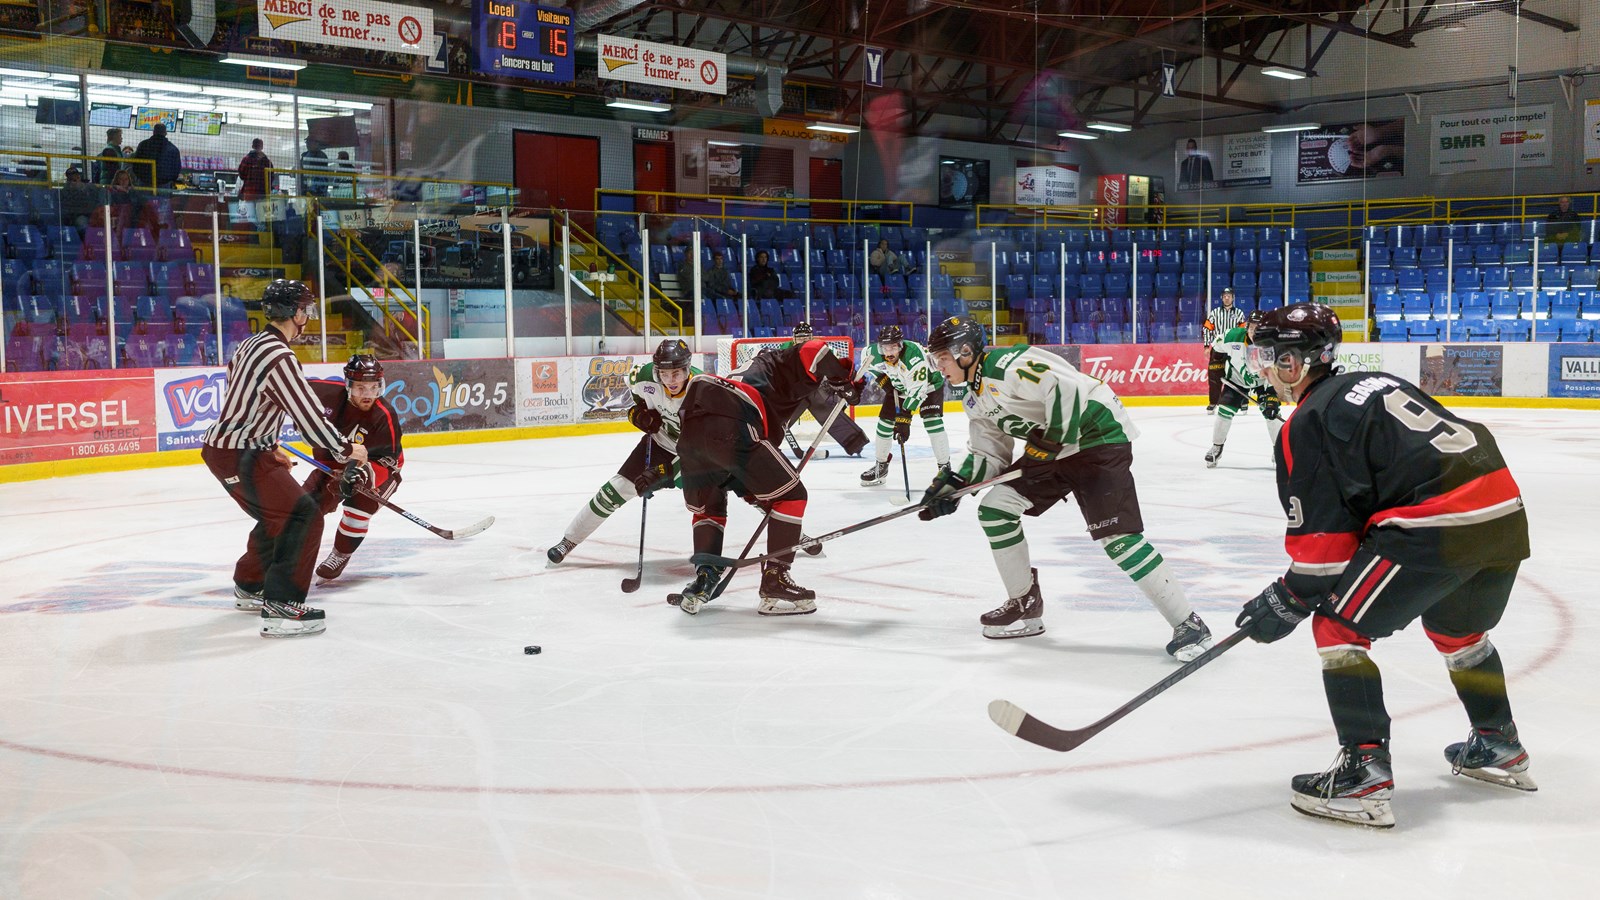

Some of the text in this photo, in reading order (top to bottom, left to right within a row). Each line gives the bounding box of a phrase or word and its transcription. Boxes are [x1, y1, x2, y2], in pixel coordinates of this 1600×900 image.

[319, 4, 336, 18] de
[342, 9, 360, 21] ne
[366, 13, 391, 26] pas
[489, 1, 514, 17] Local
[537, 10, 570, 25] Visiteurs
[549, 29, 567, 56] 16
[501, 54, 554, 73] lancers au but
[642, 50, 655, 62] de
[660, 55, 673, 65] ne
[677, 58, 695, 69] pas
[867, 53, 880, 83] Y
[1163, 67, 1174, 96] X
[1440, 120, 1459, 128] Pour
[1462, 118, 1479, 127] tout
[1493, 115, 1506, 125] qui
[1509, 111, 1546, 123] compte!
[638, 128, 669, 141] FEMMES
[1440, 133, 1486, 150] BMR
[1228, 151, 1248, 159] VOTRE
[1521, 151, 1545, 159] Avantis
[1325, 250, 1354, 259] Desjardins
[1327, 273, 1357, 282] Desjardins
[1329, 297, 1360, 305] Desjardins
[1339, 320, 1364, 329] sjardins
[1447, 348, 1501, 358] Pralinière
[589, 356, 634, 377] Cool
[913, 366, 927, 381] 18
[1016, 360, 1051, 384] 16
[1085, 354, 1208, 384] Tim Horton
[1566, 360, 1600, 374] VALL
[441, 382, 508, 408] 103,5
[523, 394, 568, 408] Oscar Brochu
[1, 399, 140, 434] IVERSEL
[524, 413, 568, 421] SAINT-GEORGES
[1383, 389, 1478, 453] 9
[70, 441, 140, 456] 1.800.463.4495
[402, 511, 431, 529] BAUER
